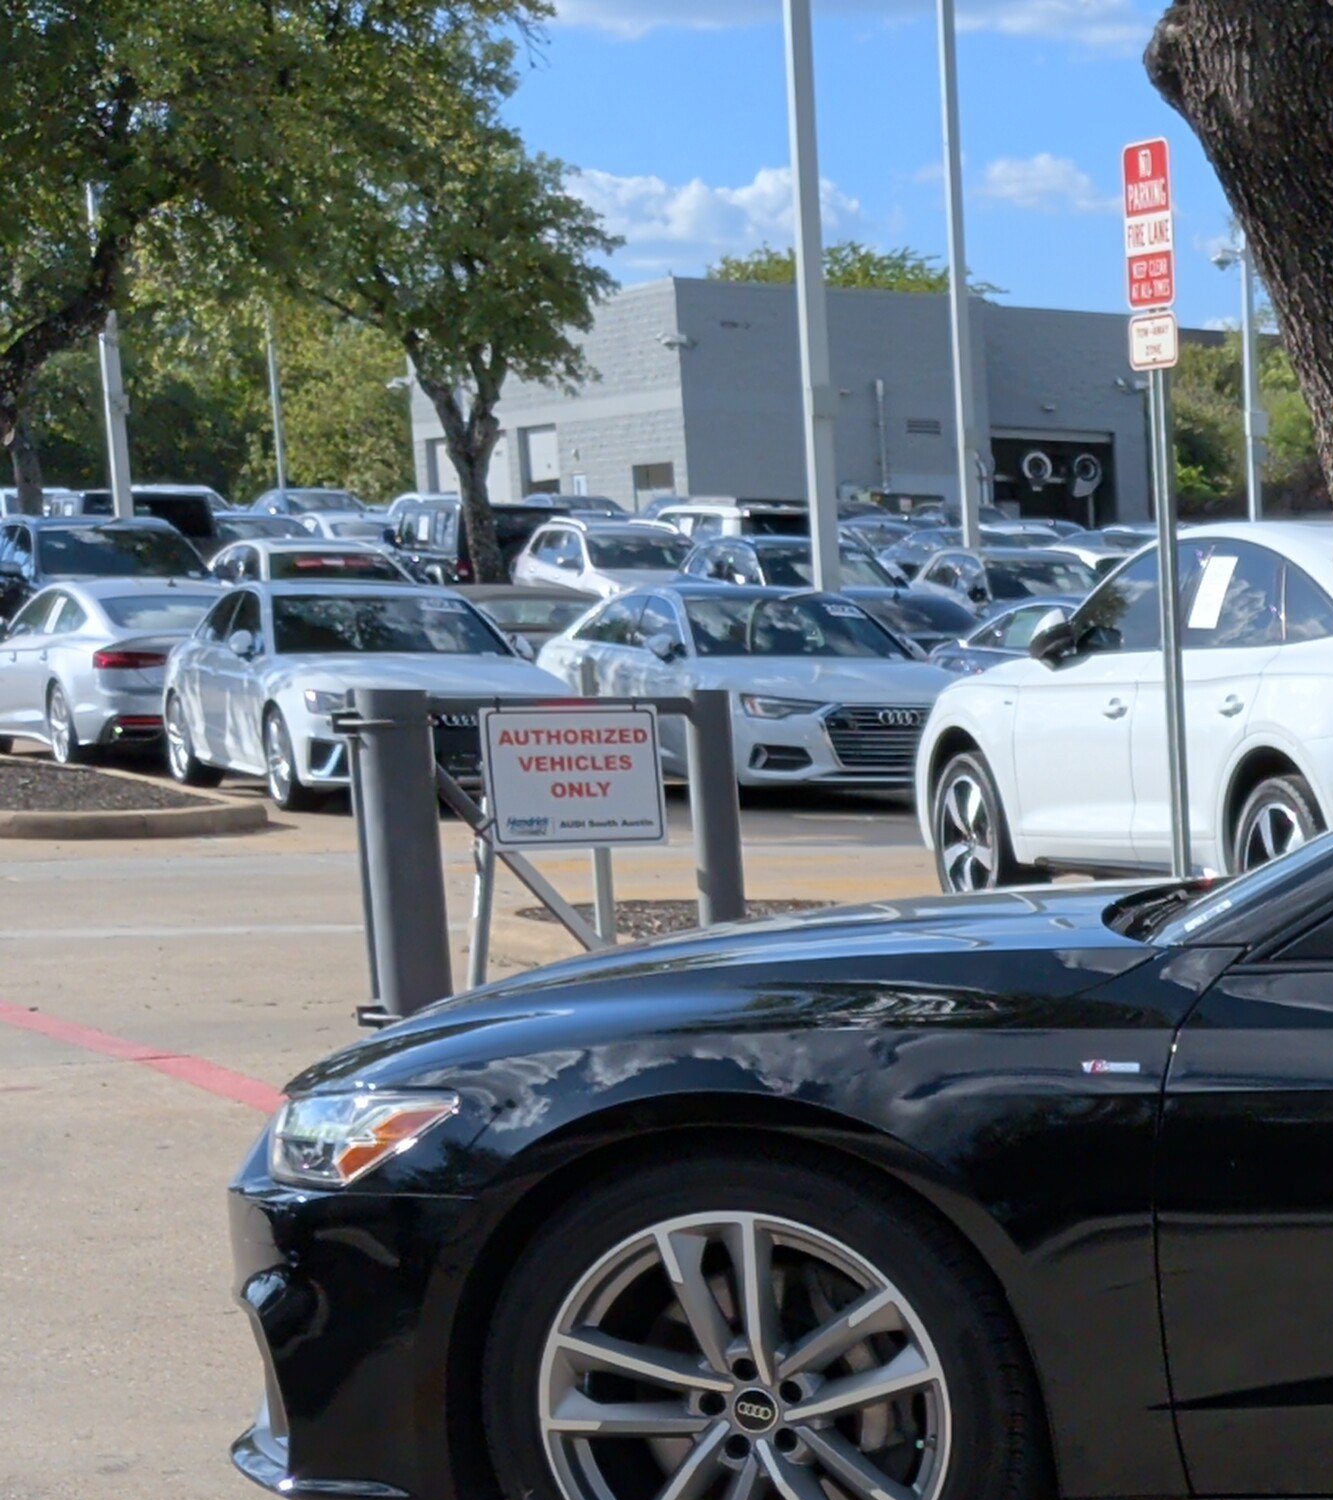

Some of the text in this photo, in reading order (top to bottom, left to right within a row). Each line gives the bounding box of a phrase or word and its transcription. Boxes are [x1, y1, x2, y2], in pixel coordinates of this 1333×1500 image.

[1138, 149, 1152, 177] NO
[1127, 178, 1167, 212] PARKING
[1128, 219, 1170, 248] FIRE LANE
[498, 728, 648, 746] AUTHORIZED
[518, 755, 633, 772] VEHICLES
[550, 782, 611, 798] ONLY
[506, 816, 654, 830] Hendrick AUDI South Austin
